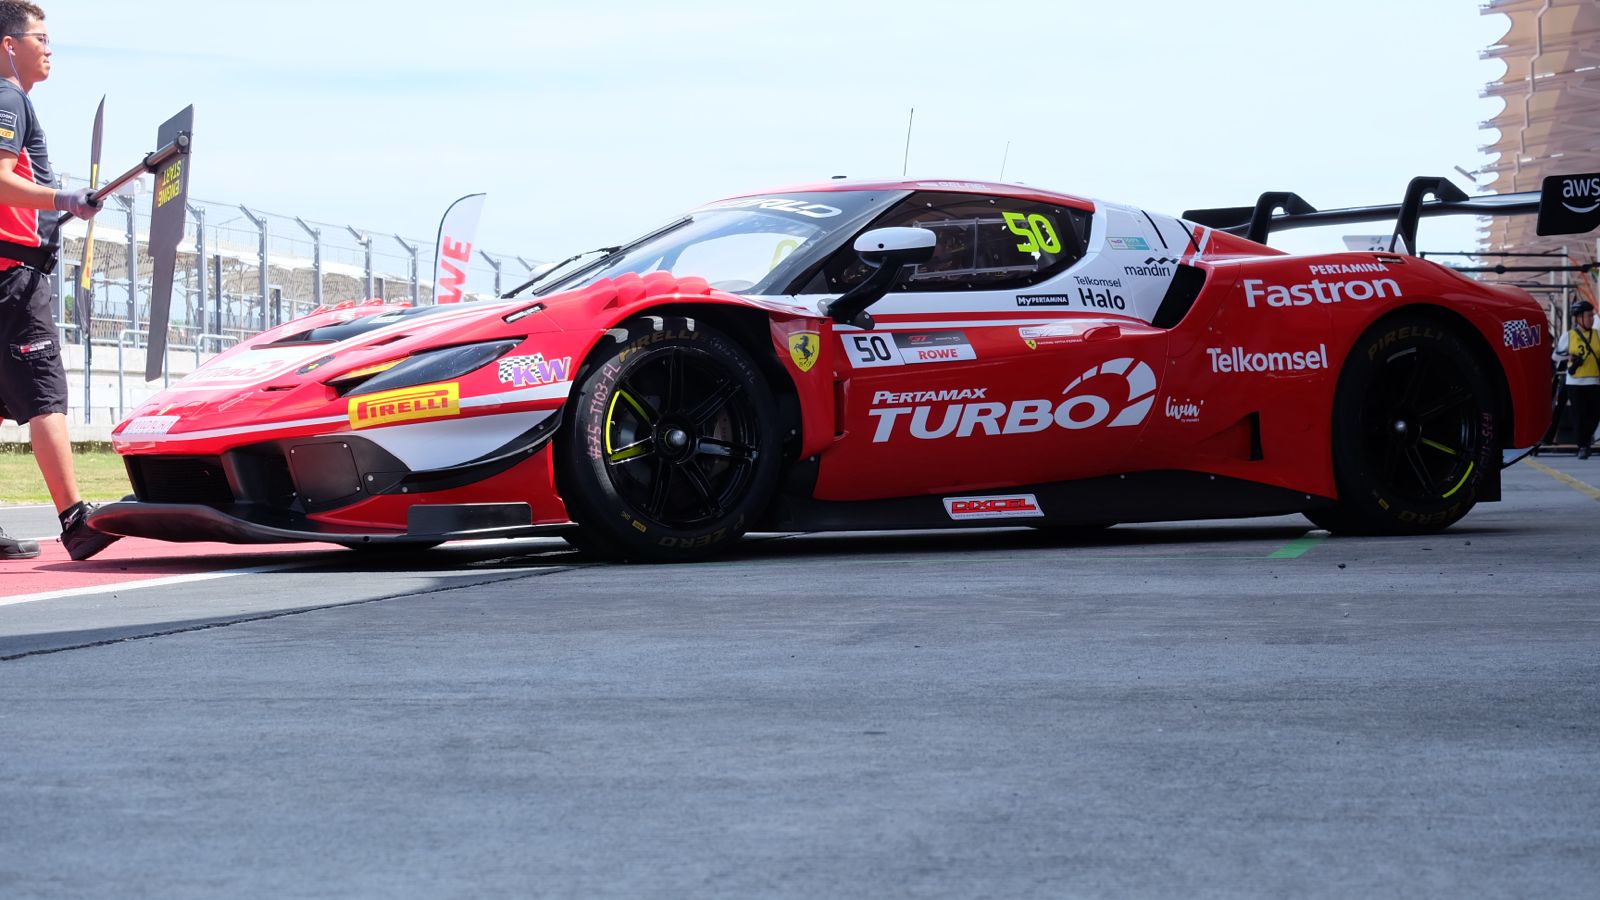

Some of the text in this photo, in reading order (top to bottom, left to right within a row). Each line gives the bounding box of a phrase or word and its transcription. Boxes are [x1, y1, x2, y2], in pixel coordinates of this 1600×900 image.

[162, 159, 182, 187] START
[157, 180, 180, 208] ENGINE
[1562, 177, 1600, 198] aws
[1002, 211, 1062, 254] 50
[1073, 276, 1122, 288] Telkomsel
[1123, 264, 1171, 277] mandiri
[1308, 263, 1389, 276] PERTAMINA
[1078, 287, 1125, 310] Halo
[1243, 277, 1402, 308] Fastron
[618, 329, 700, 364] PIRELLI
[853, 335, 892, 363] 50
[1367, 325, 1444, 361] PIRELLI
[1511, 324, 1541, 351] KW
[917, 348, 959, 360] ROWE
[1206, 343, 1328, 373] Telkomsel
[512, 356, 572, 387] KW
[357, 389, 449, 421] PIRELLI
[871, 387, 988, 405] PERTAMAX
[868, 395, 1110, 443] TURBO
